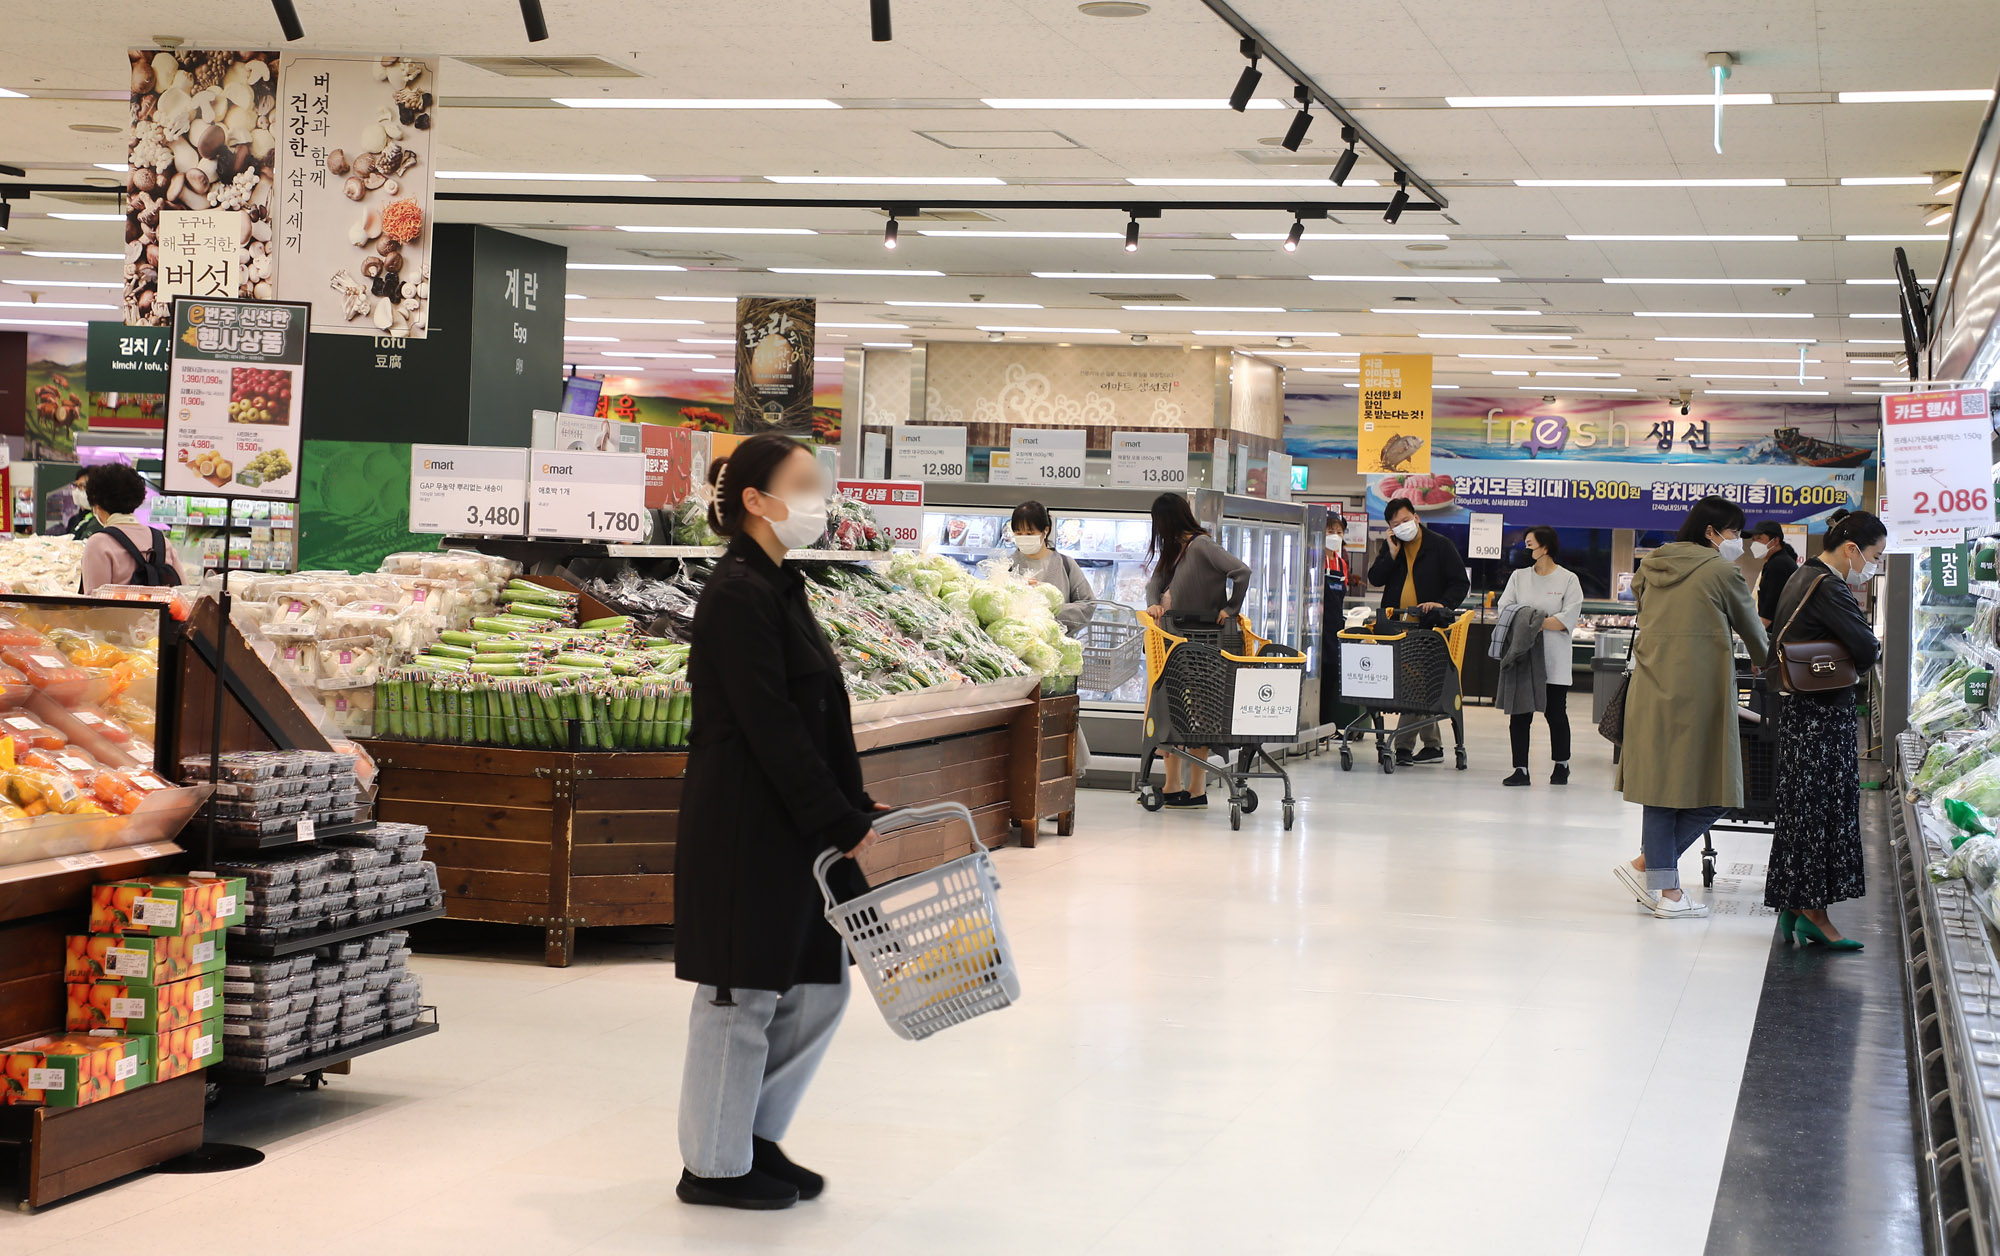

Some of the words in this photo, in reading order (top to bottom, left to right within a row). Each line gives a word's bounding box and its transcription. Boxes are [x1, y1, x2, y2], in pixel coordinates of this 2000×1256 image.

[311, 72, 330, 137] 버섯과
[288, 92, 309, 158] 건강한
[309, 146, 329, 189] 함께
[285, 167, 307, 254] 삼시세끼
[178, 216, 216, 229] 누구나,
[165, 259, 230, 297] 버섯
[504, 268, 539, 311] 계란
[239, 307, 290, 329] 신선한
[513, 322, 527, 344] Egg
[198, 326, 284, 354] 행사상품
[373, 336, 406, 349] Tofu
[119, 338, 148, 356] 김치
[112, 361, 137, 371] kimchi
[144, 361, 163, 371] tofu,
[1365, 358, 1383, 368] 지금
[1138, 380, 1172, 393] 생선회
[1365, 378, 1391, 388] 없다는
[1364, 390, 1392, 400] 신선한
[1392, 390, 1402, 400] 회
[596, 394, 639, 422] 정육
[1364, 400, 1382, 409] 할인
[1894, 404, 1923, 420] 카드
[1926, 400, 1957, 417] 행사
[1364, 410, 1373, 420] 못
[1374, 410, 1410, 420] 받는다는
[1482, 407, 1630, 448] fresh
[1645, 419, 1711, 452] 생선
[1963, 432, 1982, 440] 150g
[1120, 440, 1141, 448] emart
[423, 459, 454, 470] emart
[542, 463, 573, 475] emart
[922, 463, 962, 476] 12,980
[1040, 466, 1081, 479] 13,800
[1142, 469, 1184, 482] 13,800
[1828, 473, 1856, 482] emart
[419, 482, 435, 490] GAP
[436, 483, 456, 491] 무농약
[484, 484, 503, 493] 새송이
[538, 486, 557, 496] 애호박
[559, 487, 570, 496] 1개
[1571, 480, 1641, 501] 15,800원
[842, 488, 863, 501] 광고
[865, 489, 887, 501] 상품
[1774, 485, 1849, 507] 16,800원
[1914, 488, 1988, 516] 2,086
[467, 505, 520, 527] 3,480
[587, 510, 639, 533] 1,780
[883, 526, 918, 541] 3380
[1475, 545, 1500, 555] 9,900
[1941, 552, 1959, 587] 맛집
[1346, 672, 1363, 680] 센트럴
[1364, 673, 1375, 682] 서울
[1376, 674, 1389, 682] 안과
[1239, 705, 1262, 714] 센트럴
[1262, 705, 1277, 715] 서울
[1277, 705, 1292, 715] 안과
